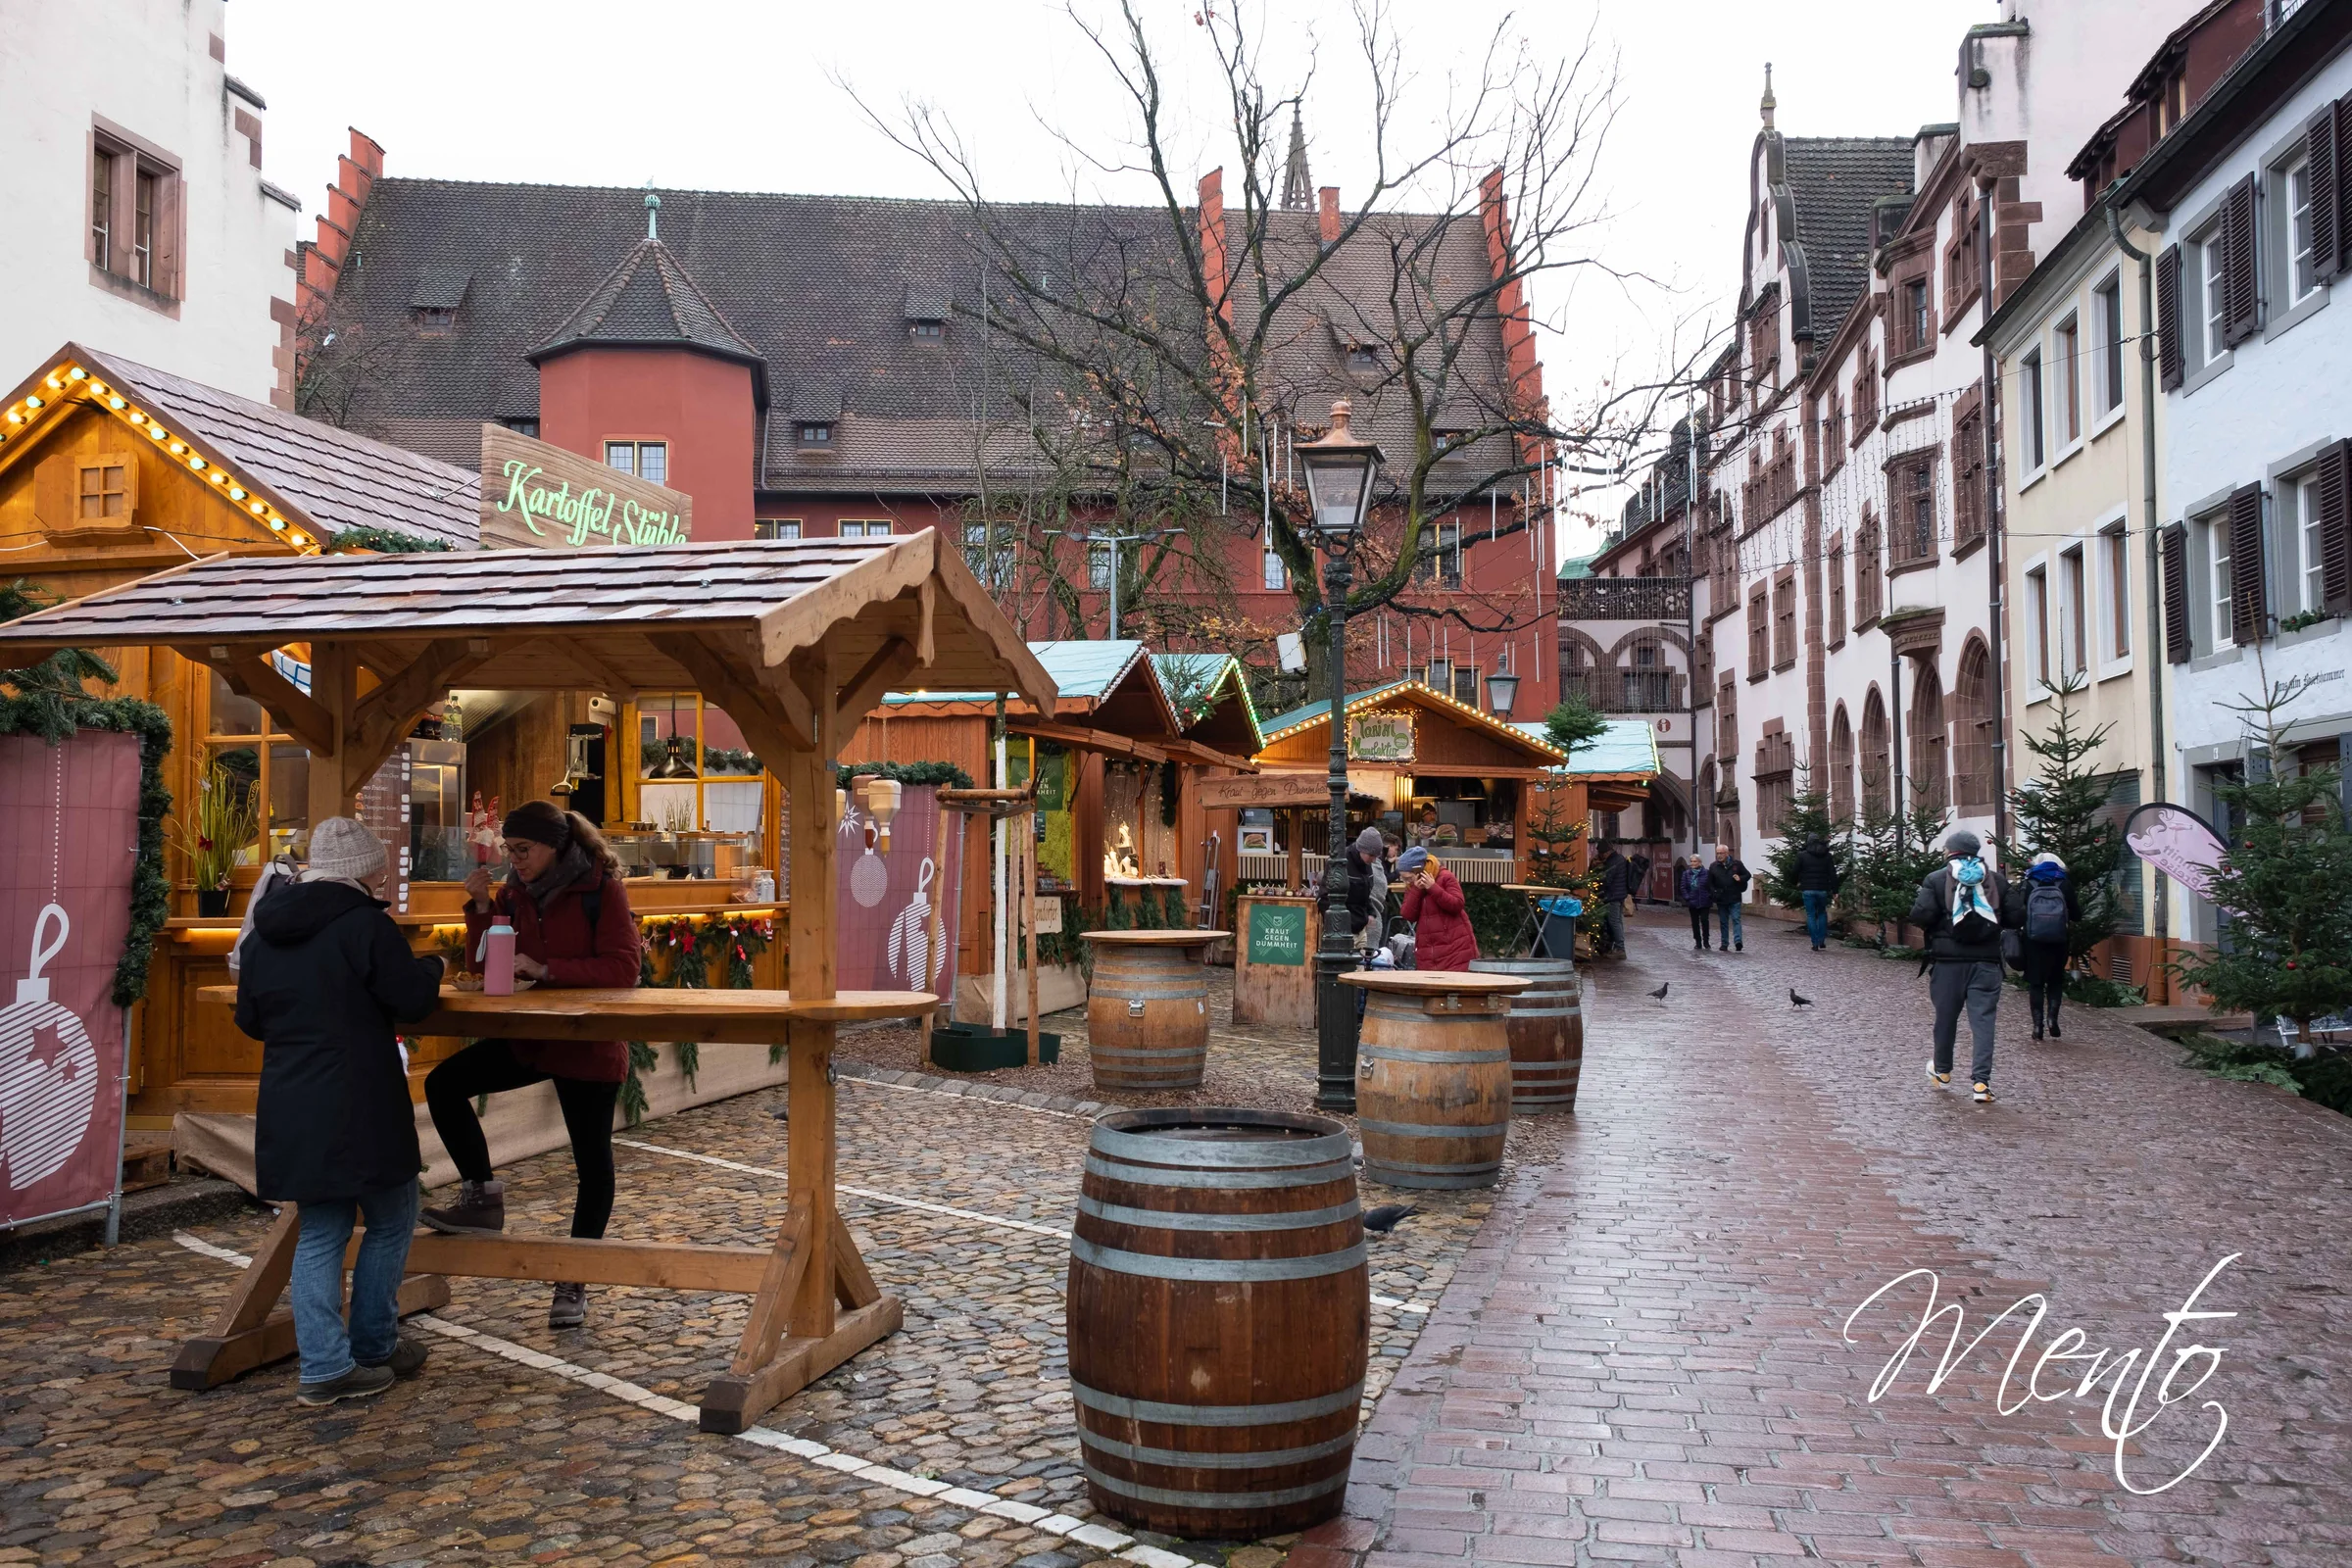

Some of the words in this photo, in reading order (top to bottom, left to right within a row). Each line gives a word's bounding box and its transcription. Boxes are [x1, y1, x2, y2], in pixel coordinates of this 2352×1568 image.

[497, 459, 614, 547] Kartoffel
[1218, 785, 1244, 799] Kraut
[1250, 787, 1276, 799] gegen
[1255, 940, 1298, 949] DUMMHEIT
